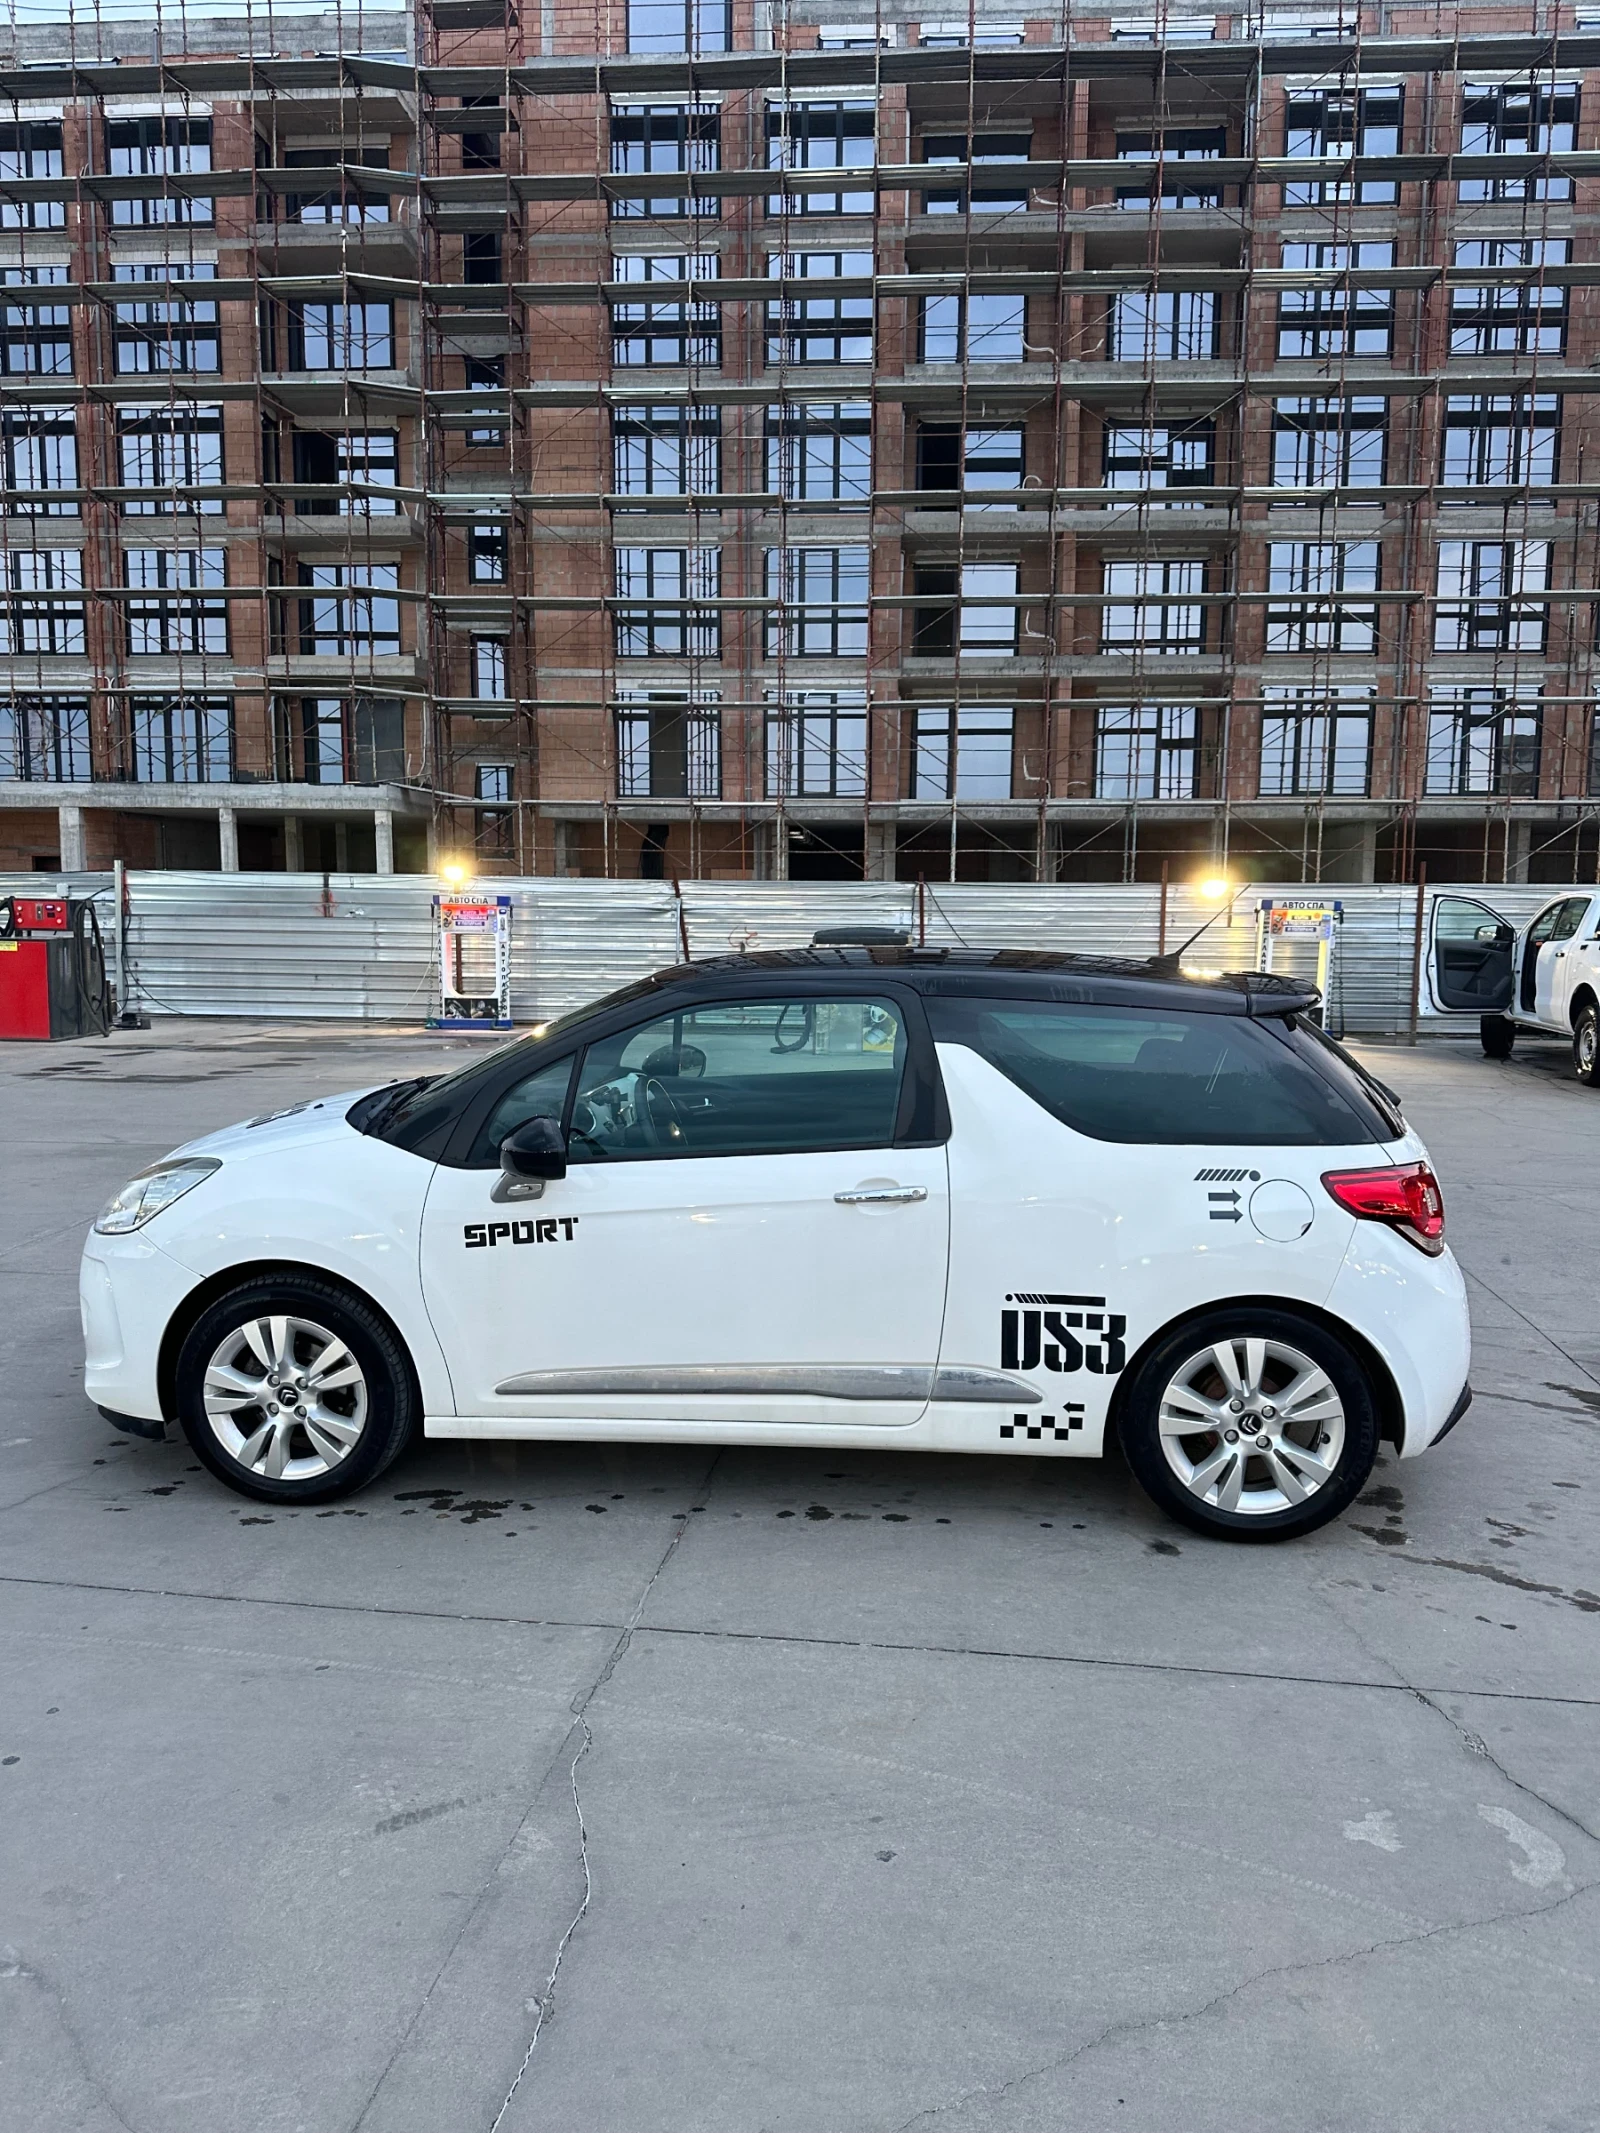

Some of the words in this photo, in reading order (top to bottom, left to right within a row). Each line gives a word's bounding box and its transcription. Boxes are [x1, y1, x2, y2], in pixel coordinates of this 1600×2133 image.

[1281, 901, 1305, 909] АВТО
[1307, 902, 1325, 910] СПА
[1260, 937, 1268, 973] ГЛАНЦ
[463, 1216, 579, 1248] SPORT
[1001, 1309, 1127, 1375] DS3
